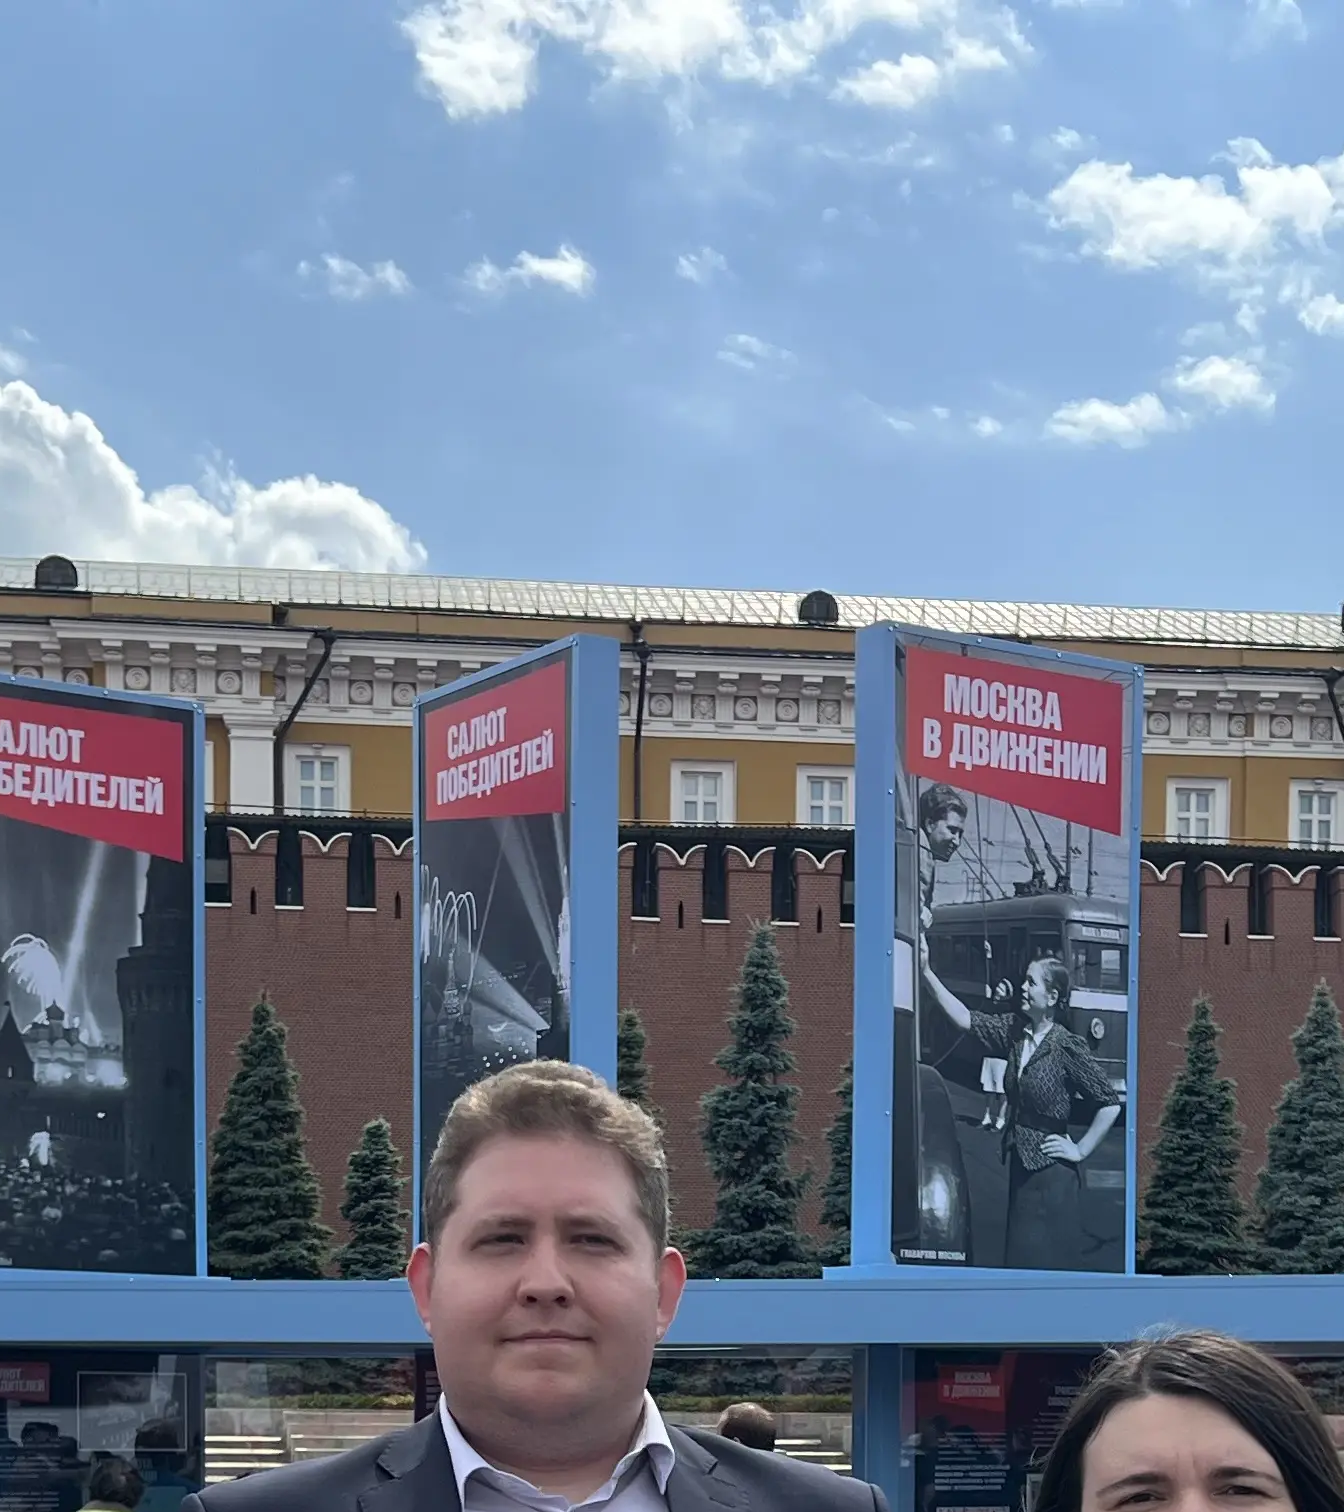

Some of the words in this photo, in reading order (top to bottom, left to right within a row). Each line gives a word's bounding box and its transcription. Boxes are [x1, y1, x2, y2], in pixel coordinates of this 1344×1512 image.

[447, 706, 507, 760] САЛЮТ
[944, 673, 1063, 732] МОСКВА
[436, 728, 554, 806] ПОБЕДИТЕЛЕЙ
[923, 717, 942, 759] В
[949, 722, 1107, 785] ДВИЖЕНИИ
